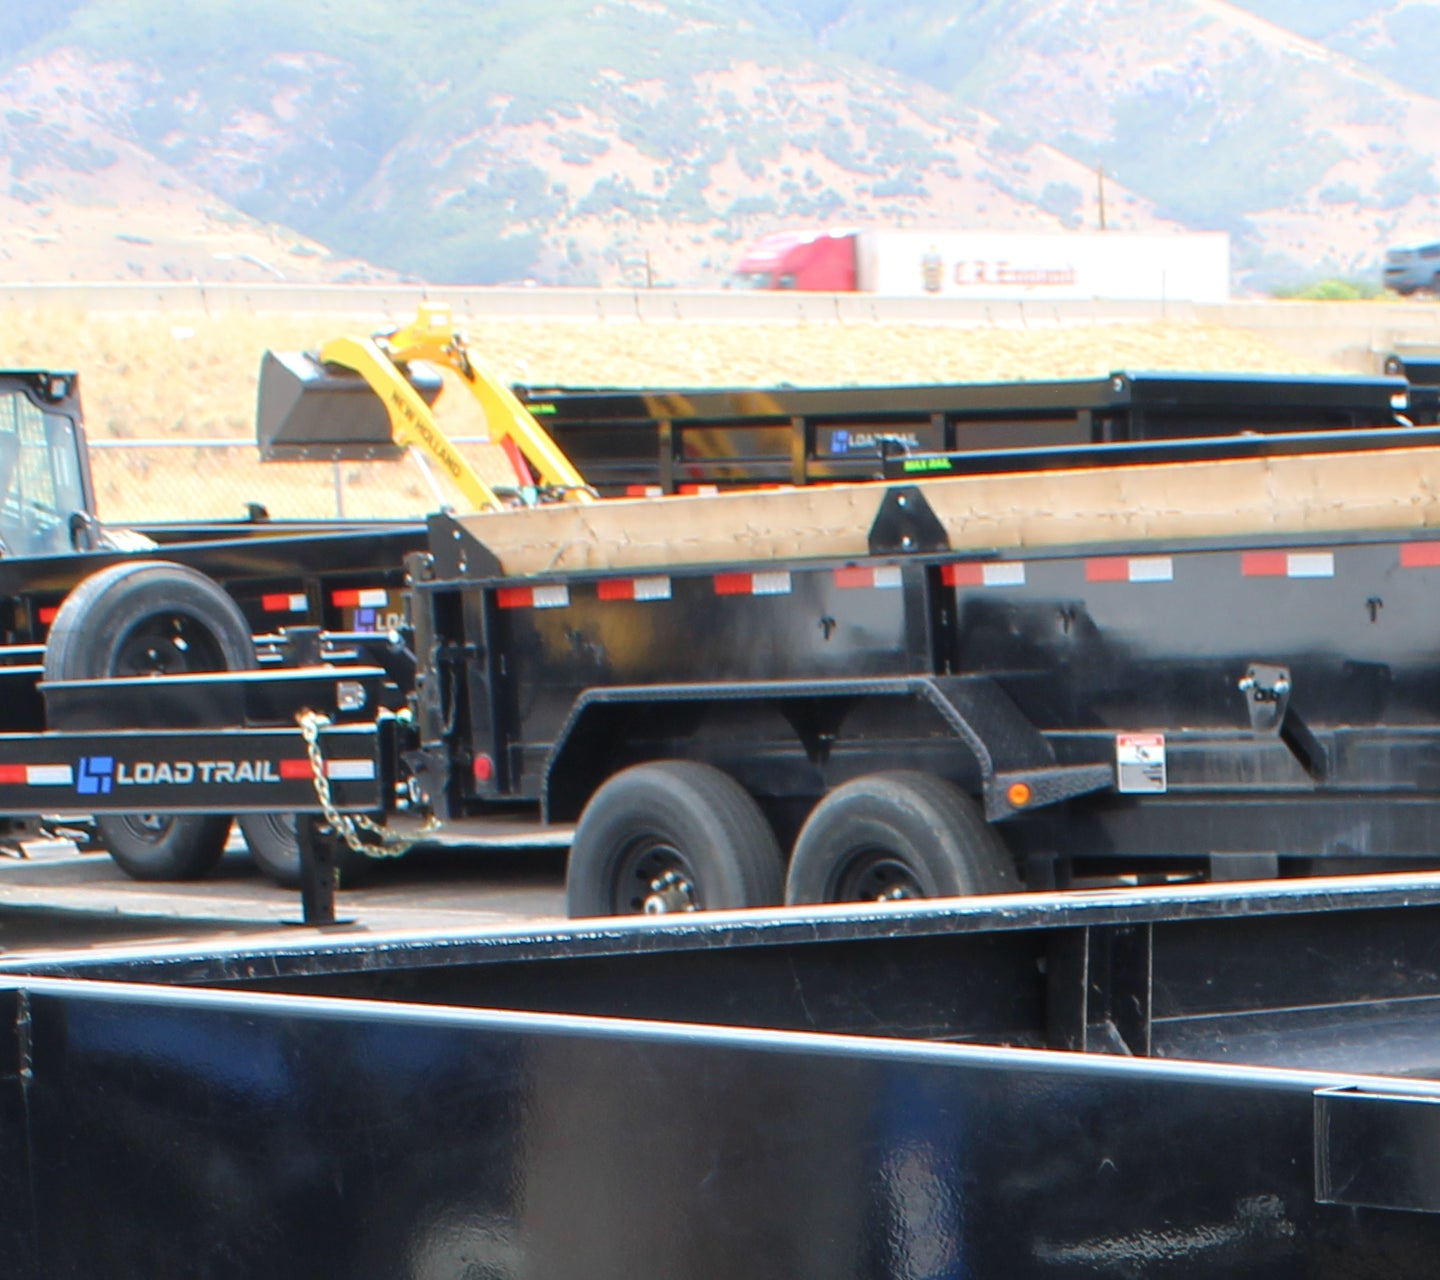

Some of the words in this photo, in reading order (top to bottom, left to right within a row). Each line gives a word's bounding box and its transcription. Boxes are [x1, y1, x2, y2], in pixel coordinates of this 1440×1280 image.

[415, 415, 460, 478] HOLLAND
[116, 761, 195, 785] LOAD
[197, 760, 281, 783] TRAIL
